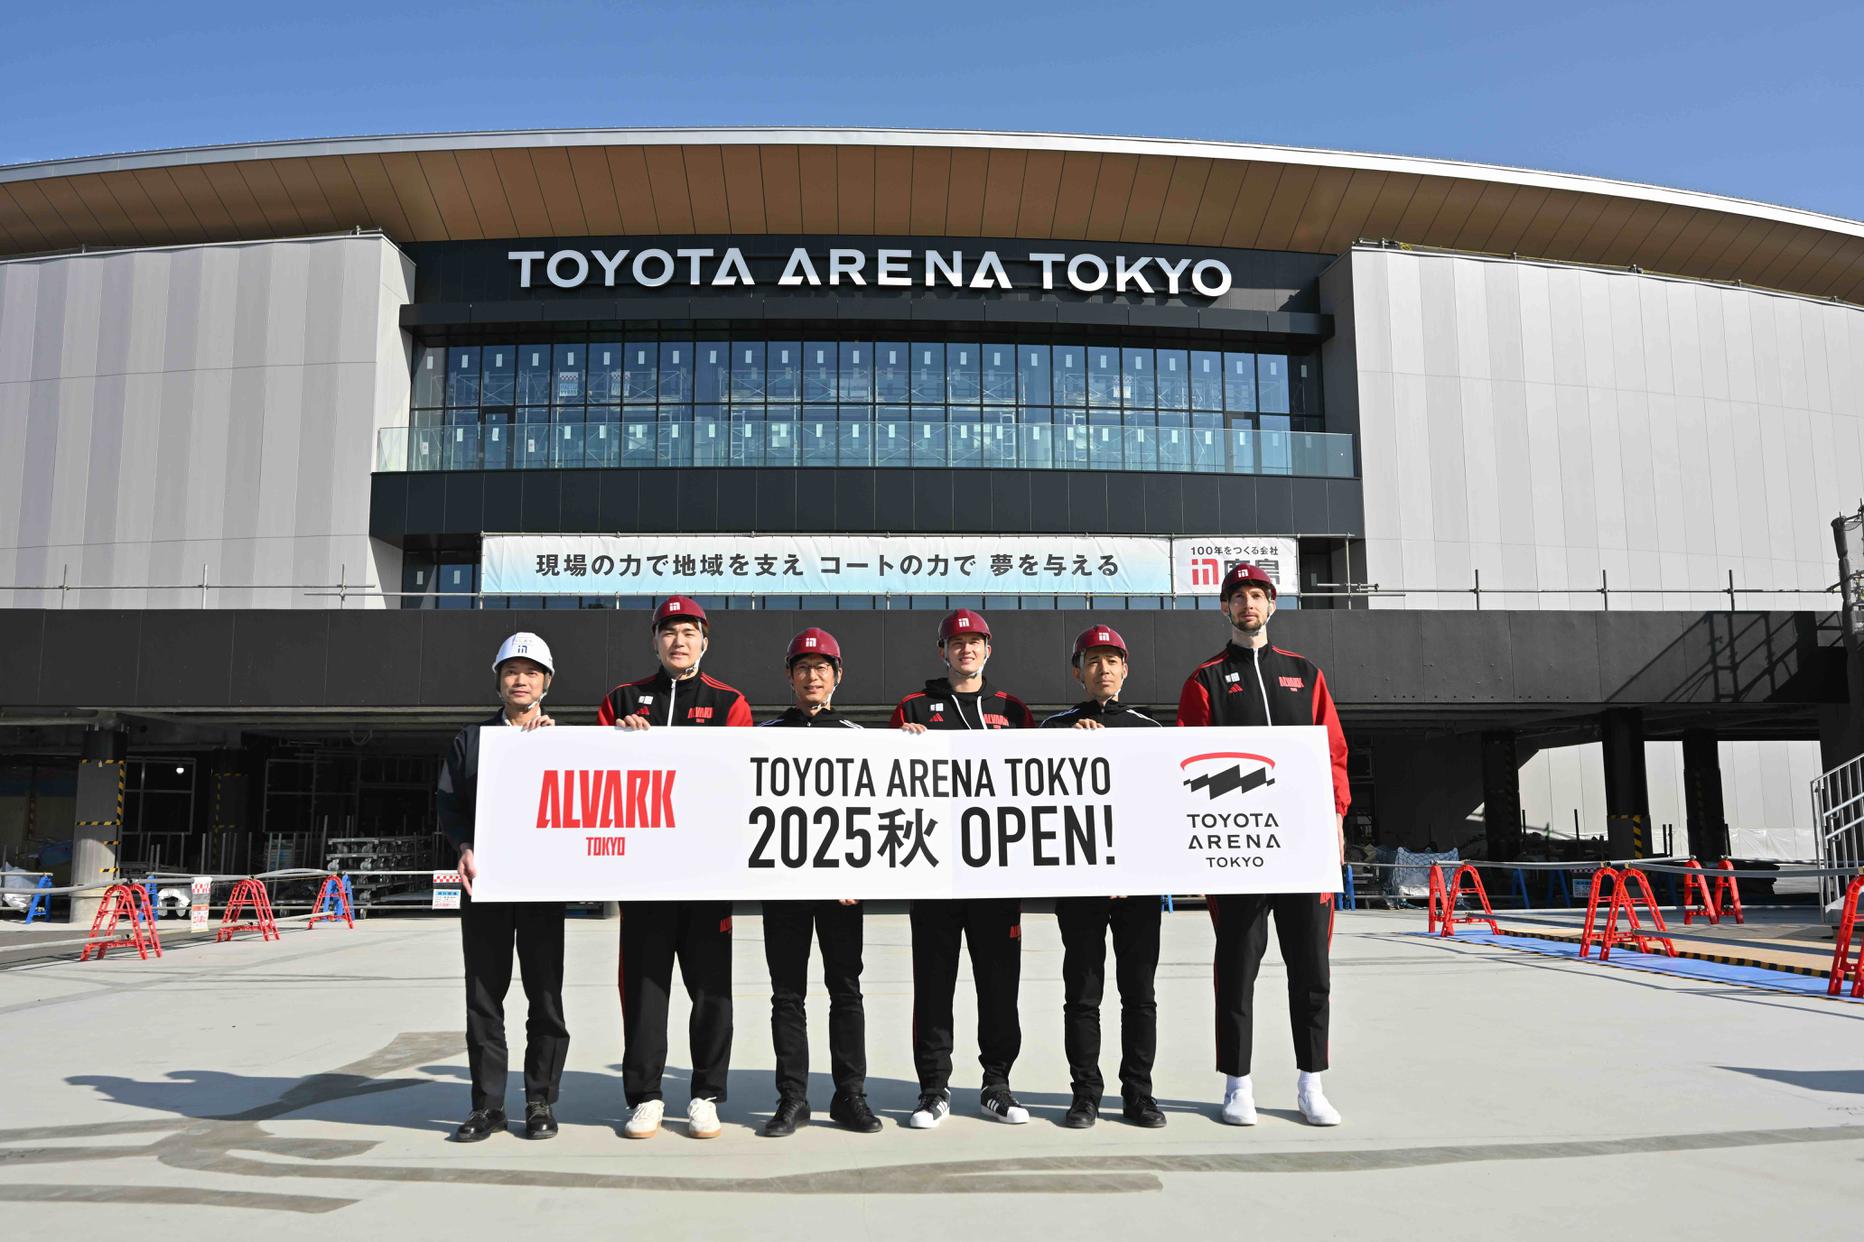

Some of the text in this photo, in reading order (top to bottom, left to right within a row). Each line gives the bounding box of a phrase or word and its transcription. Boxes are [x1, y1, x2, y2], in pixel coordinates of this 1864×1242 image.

[508, 248, 1232, 296] TOYOTA ARENA TOKYO
[1191, 546, 1279, 556] 100年をつくる会社
[535, 553, 1119, 577] 現場の力で地域を支え コートの力で 夢を与える
[750, 757, 1111, 798] TOYOTA ARENA TOKYO
[536, 769, 677, 829] ALVARK
[1186, 813, 1279, 829] TOYOTA
[586, 836, 626, 857] TOKYO
[748, 804, 1116, 869] 2025秋 OPEN!
[1188, 834, 1281, 850] ARENA
[1206, 856, 1264, 868] TOKYO
